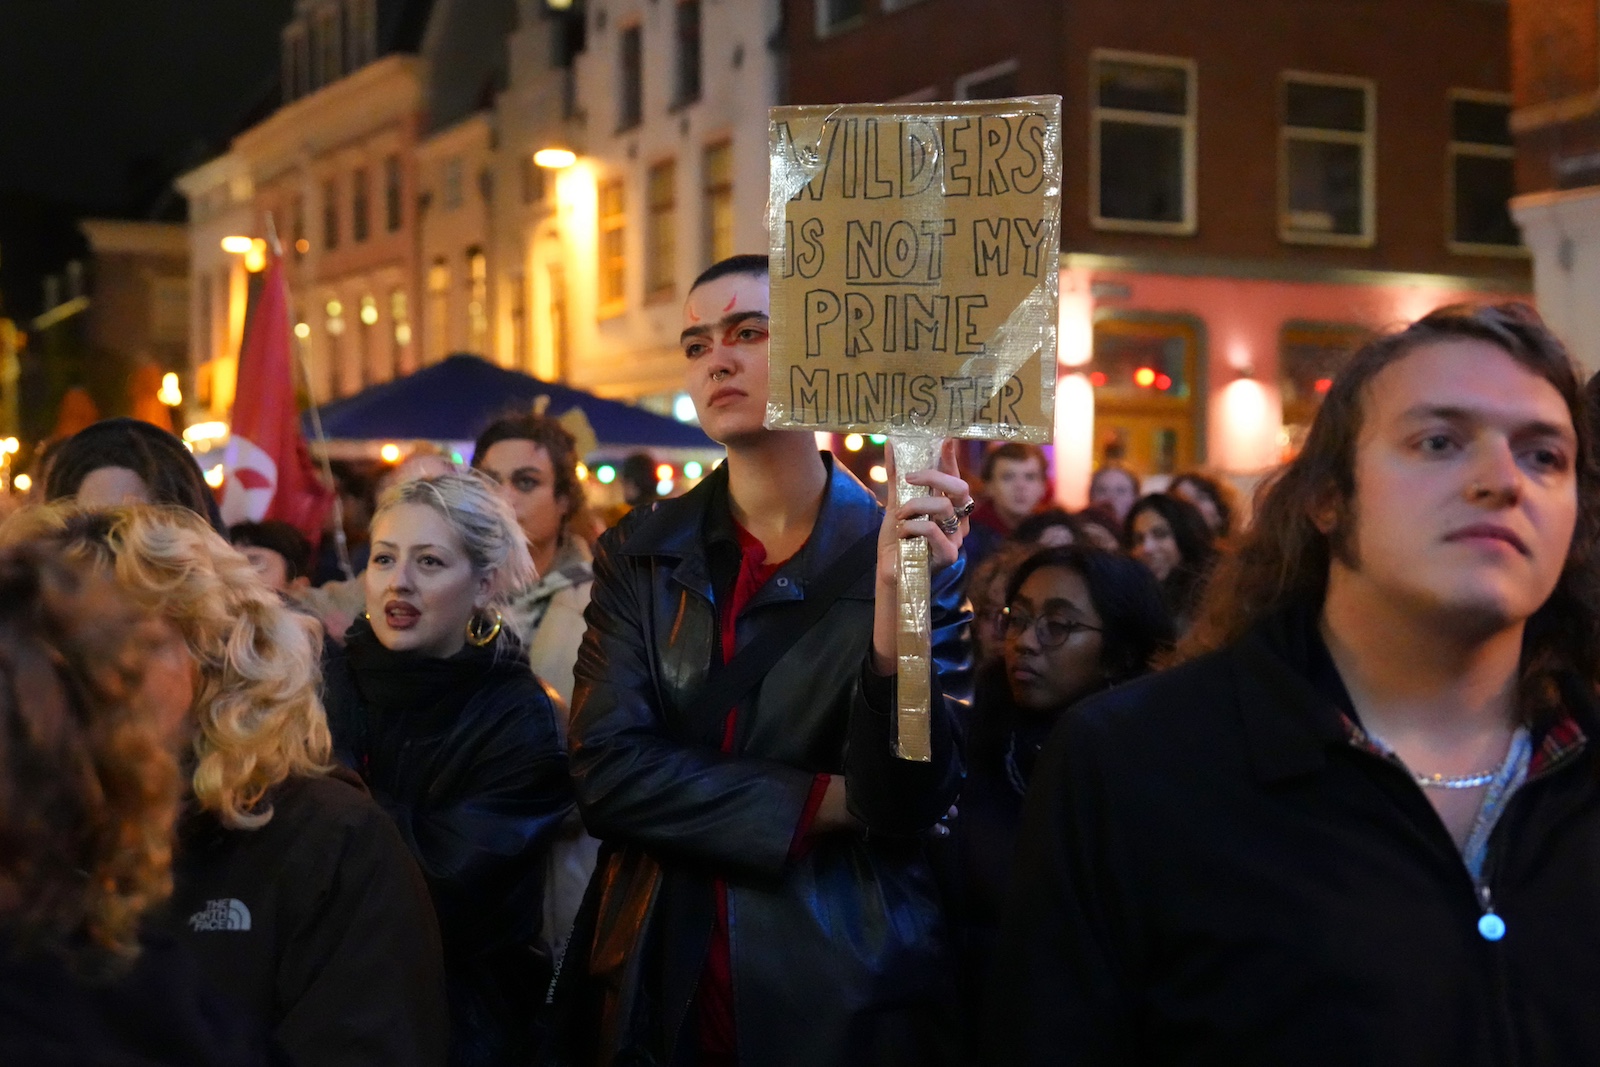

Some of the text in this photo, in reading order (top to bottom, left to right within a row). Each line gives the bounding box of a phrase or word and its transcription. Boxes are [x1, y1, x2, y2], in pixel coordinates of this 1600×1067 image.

[776, 114, 1049, 201] WILDERS
[783, 217, 1050, 282] IS NOT MY
[805, 289, 988, 359] PRIME
[790, 365, 1023, 431] MINISTER
[194, 919, 228, 932] FACE
[206, 899, 228, 910] THE
